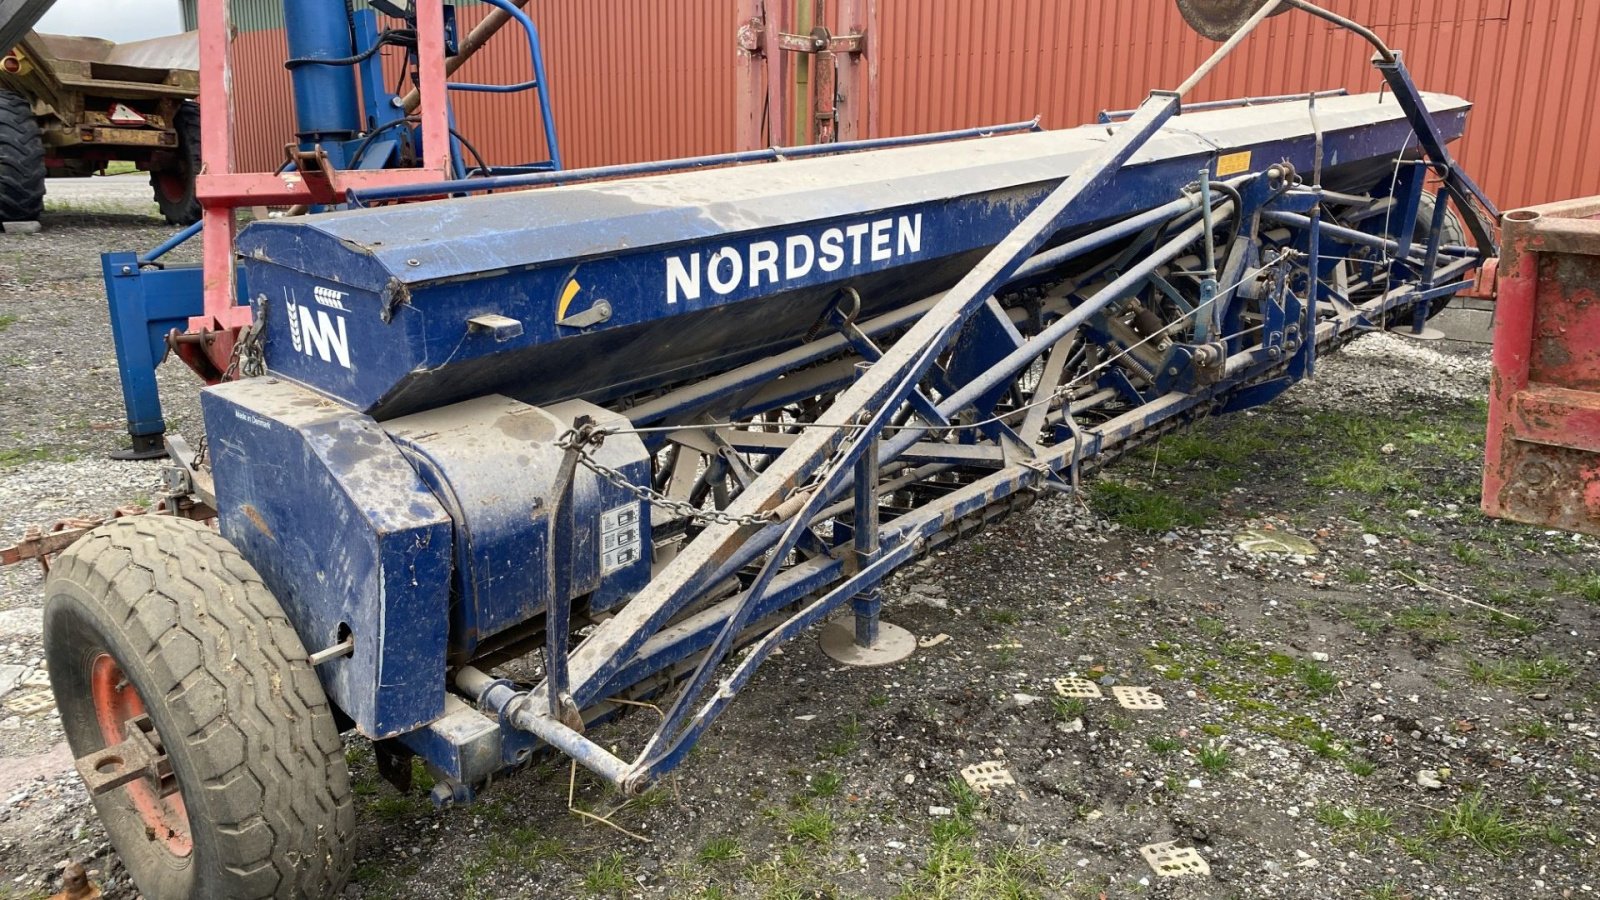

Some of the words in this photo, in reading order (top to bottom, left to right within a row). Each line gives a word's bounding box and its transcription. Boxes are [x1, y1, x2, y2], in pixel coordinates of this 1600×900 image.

[666, 213, 922, 304] NORDSTEN
[235, 409, 247, 421] Made
[252, 415, 271, 430] Denmark
